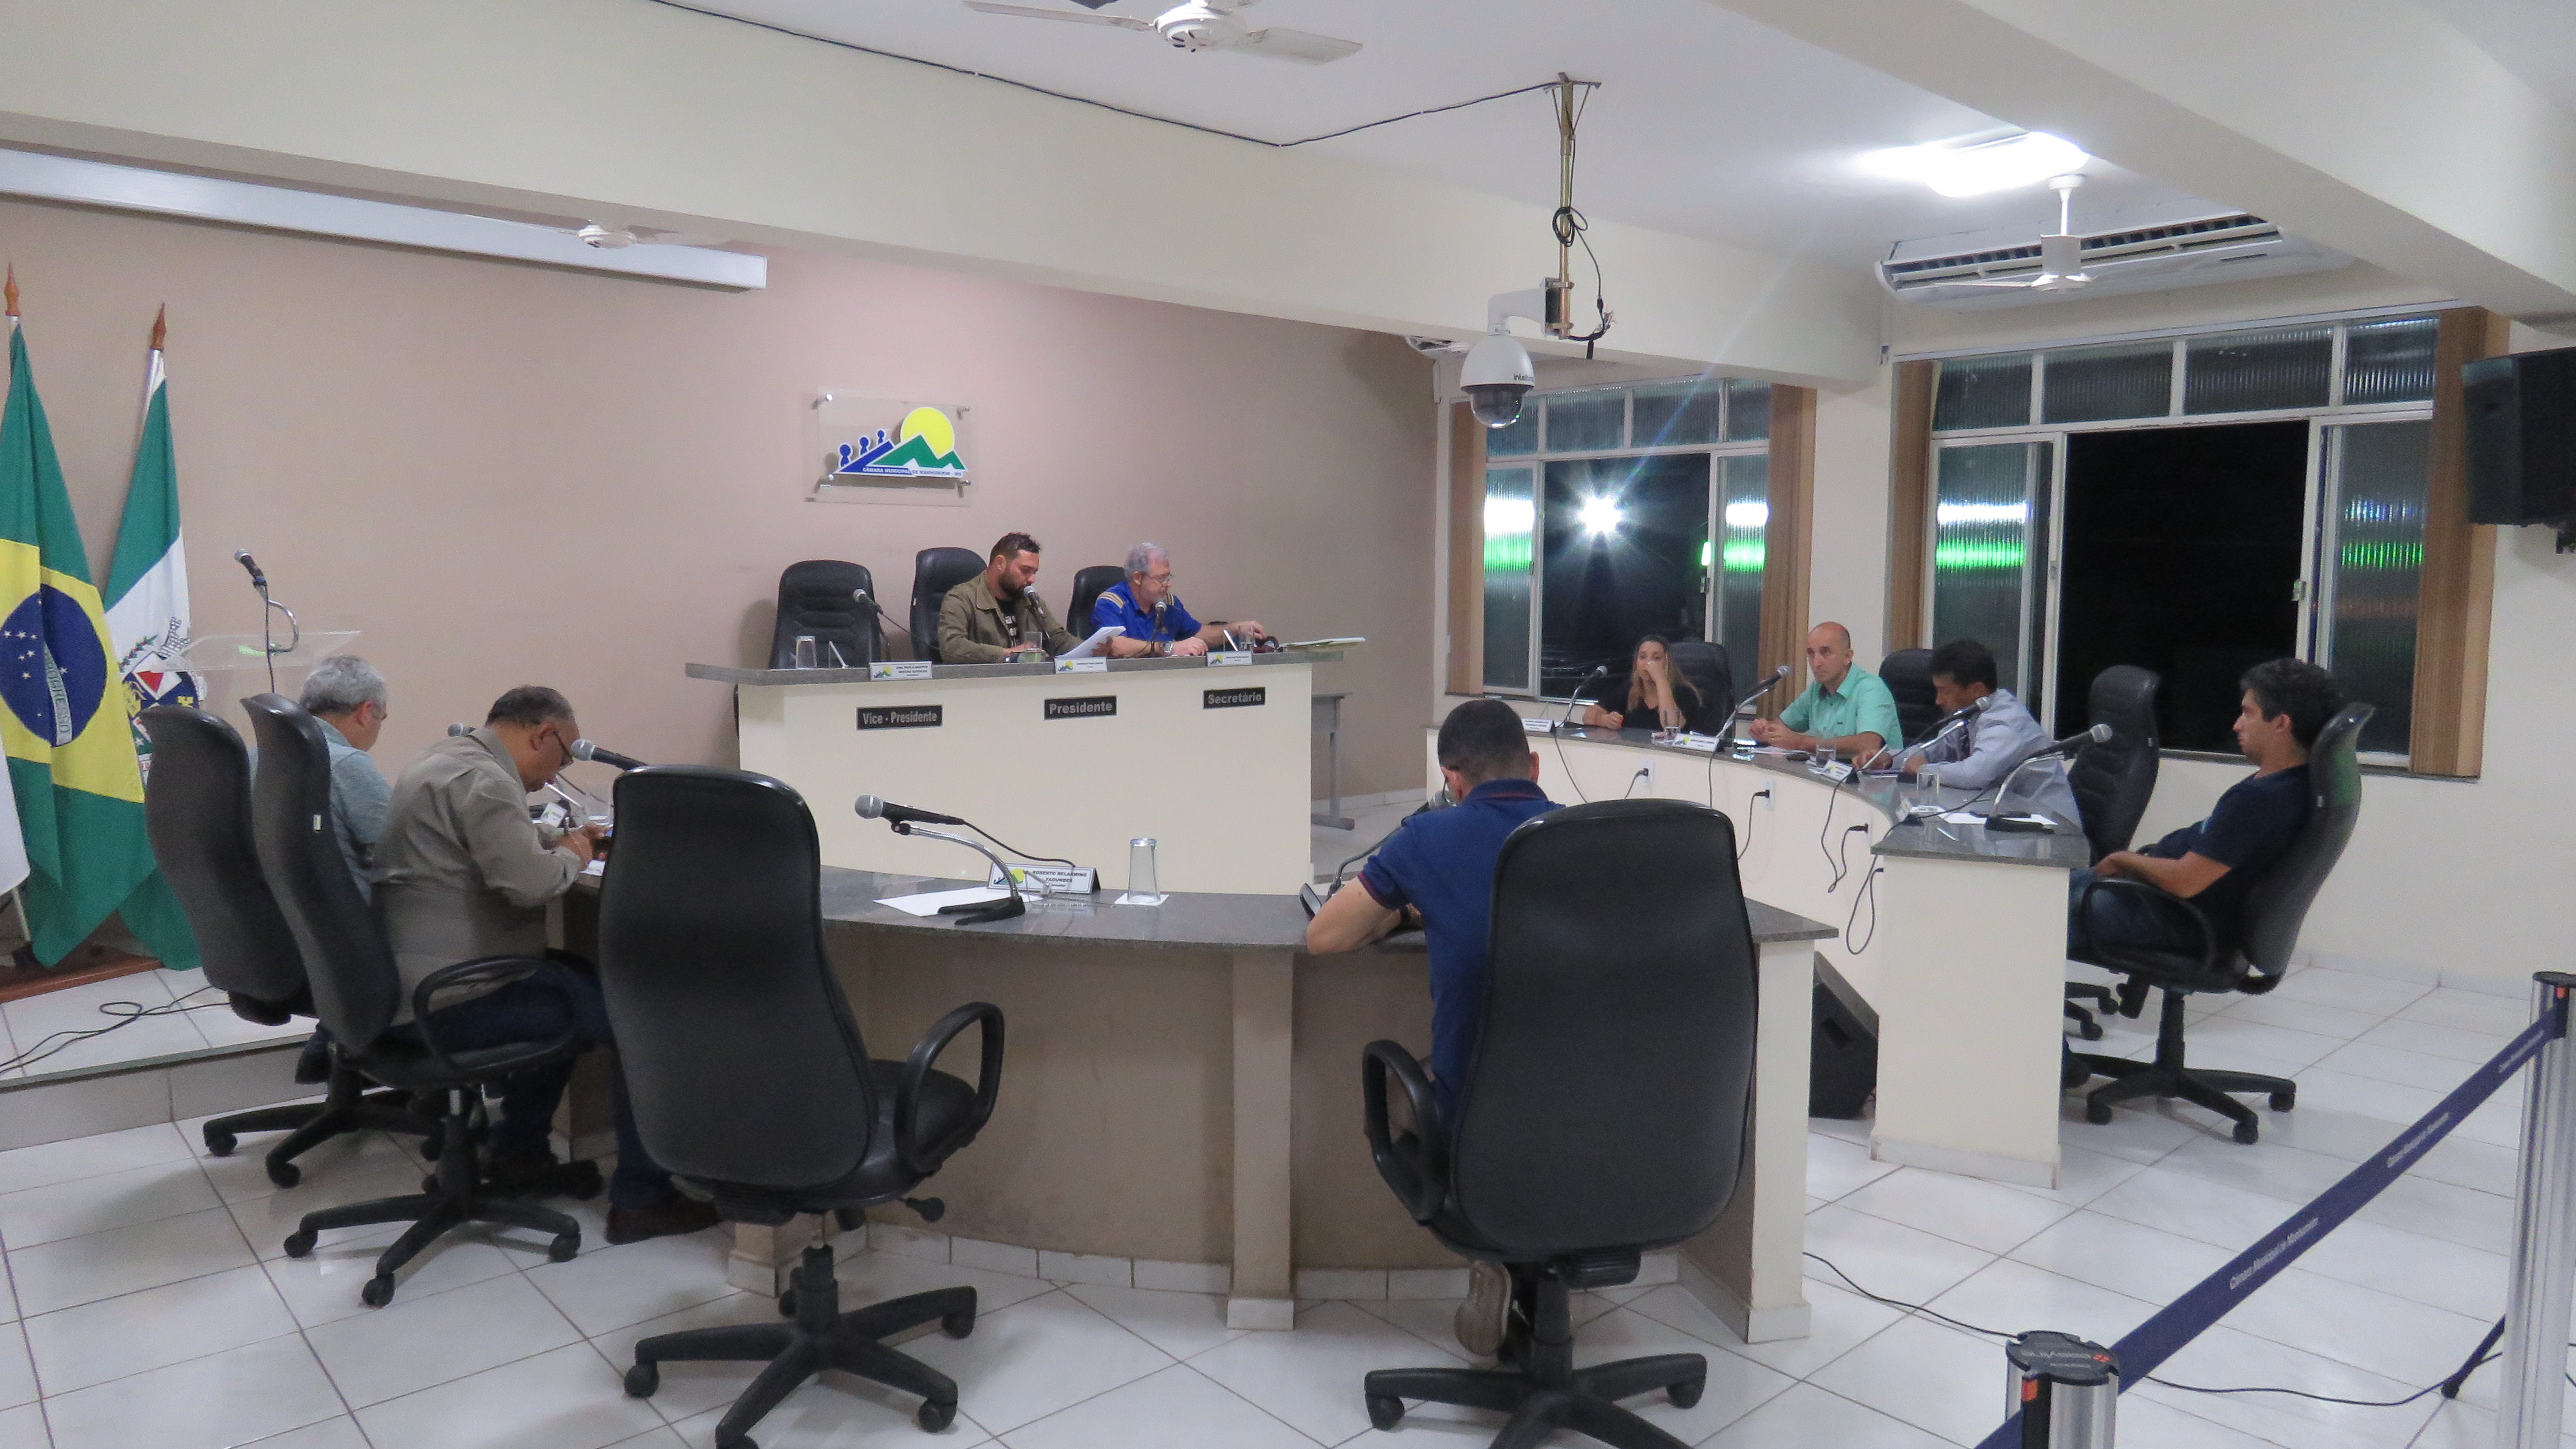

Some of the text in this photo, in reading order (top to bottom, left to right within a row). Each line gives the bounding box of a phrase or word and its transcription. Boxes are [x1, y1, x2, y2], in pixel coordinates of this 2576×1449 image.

[1208, 692, 1262, 704] Secretário
[1049, 701, 1112, 714] Presidente
[863, 712, 883, 724] Vice
[891, 711, 937, 723] Presidente
